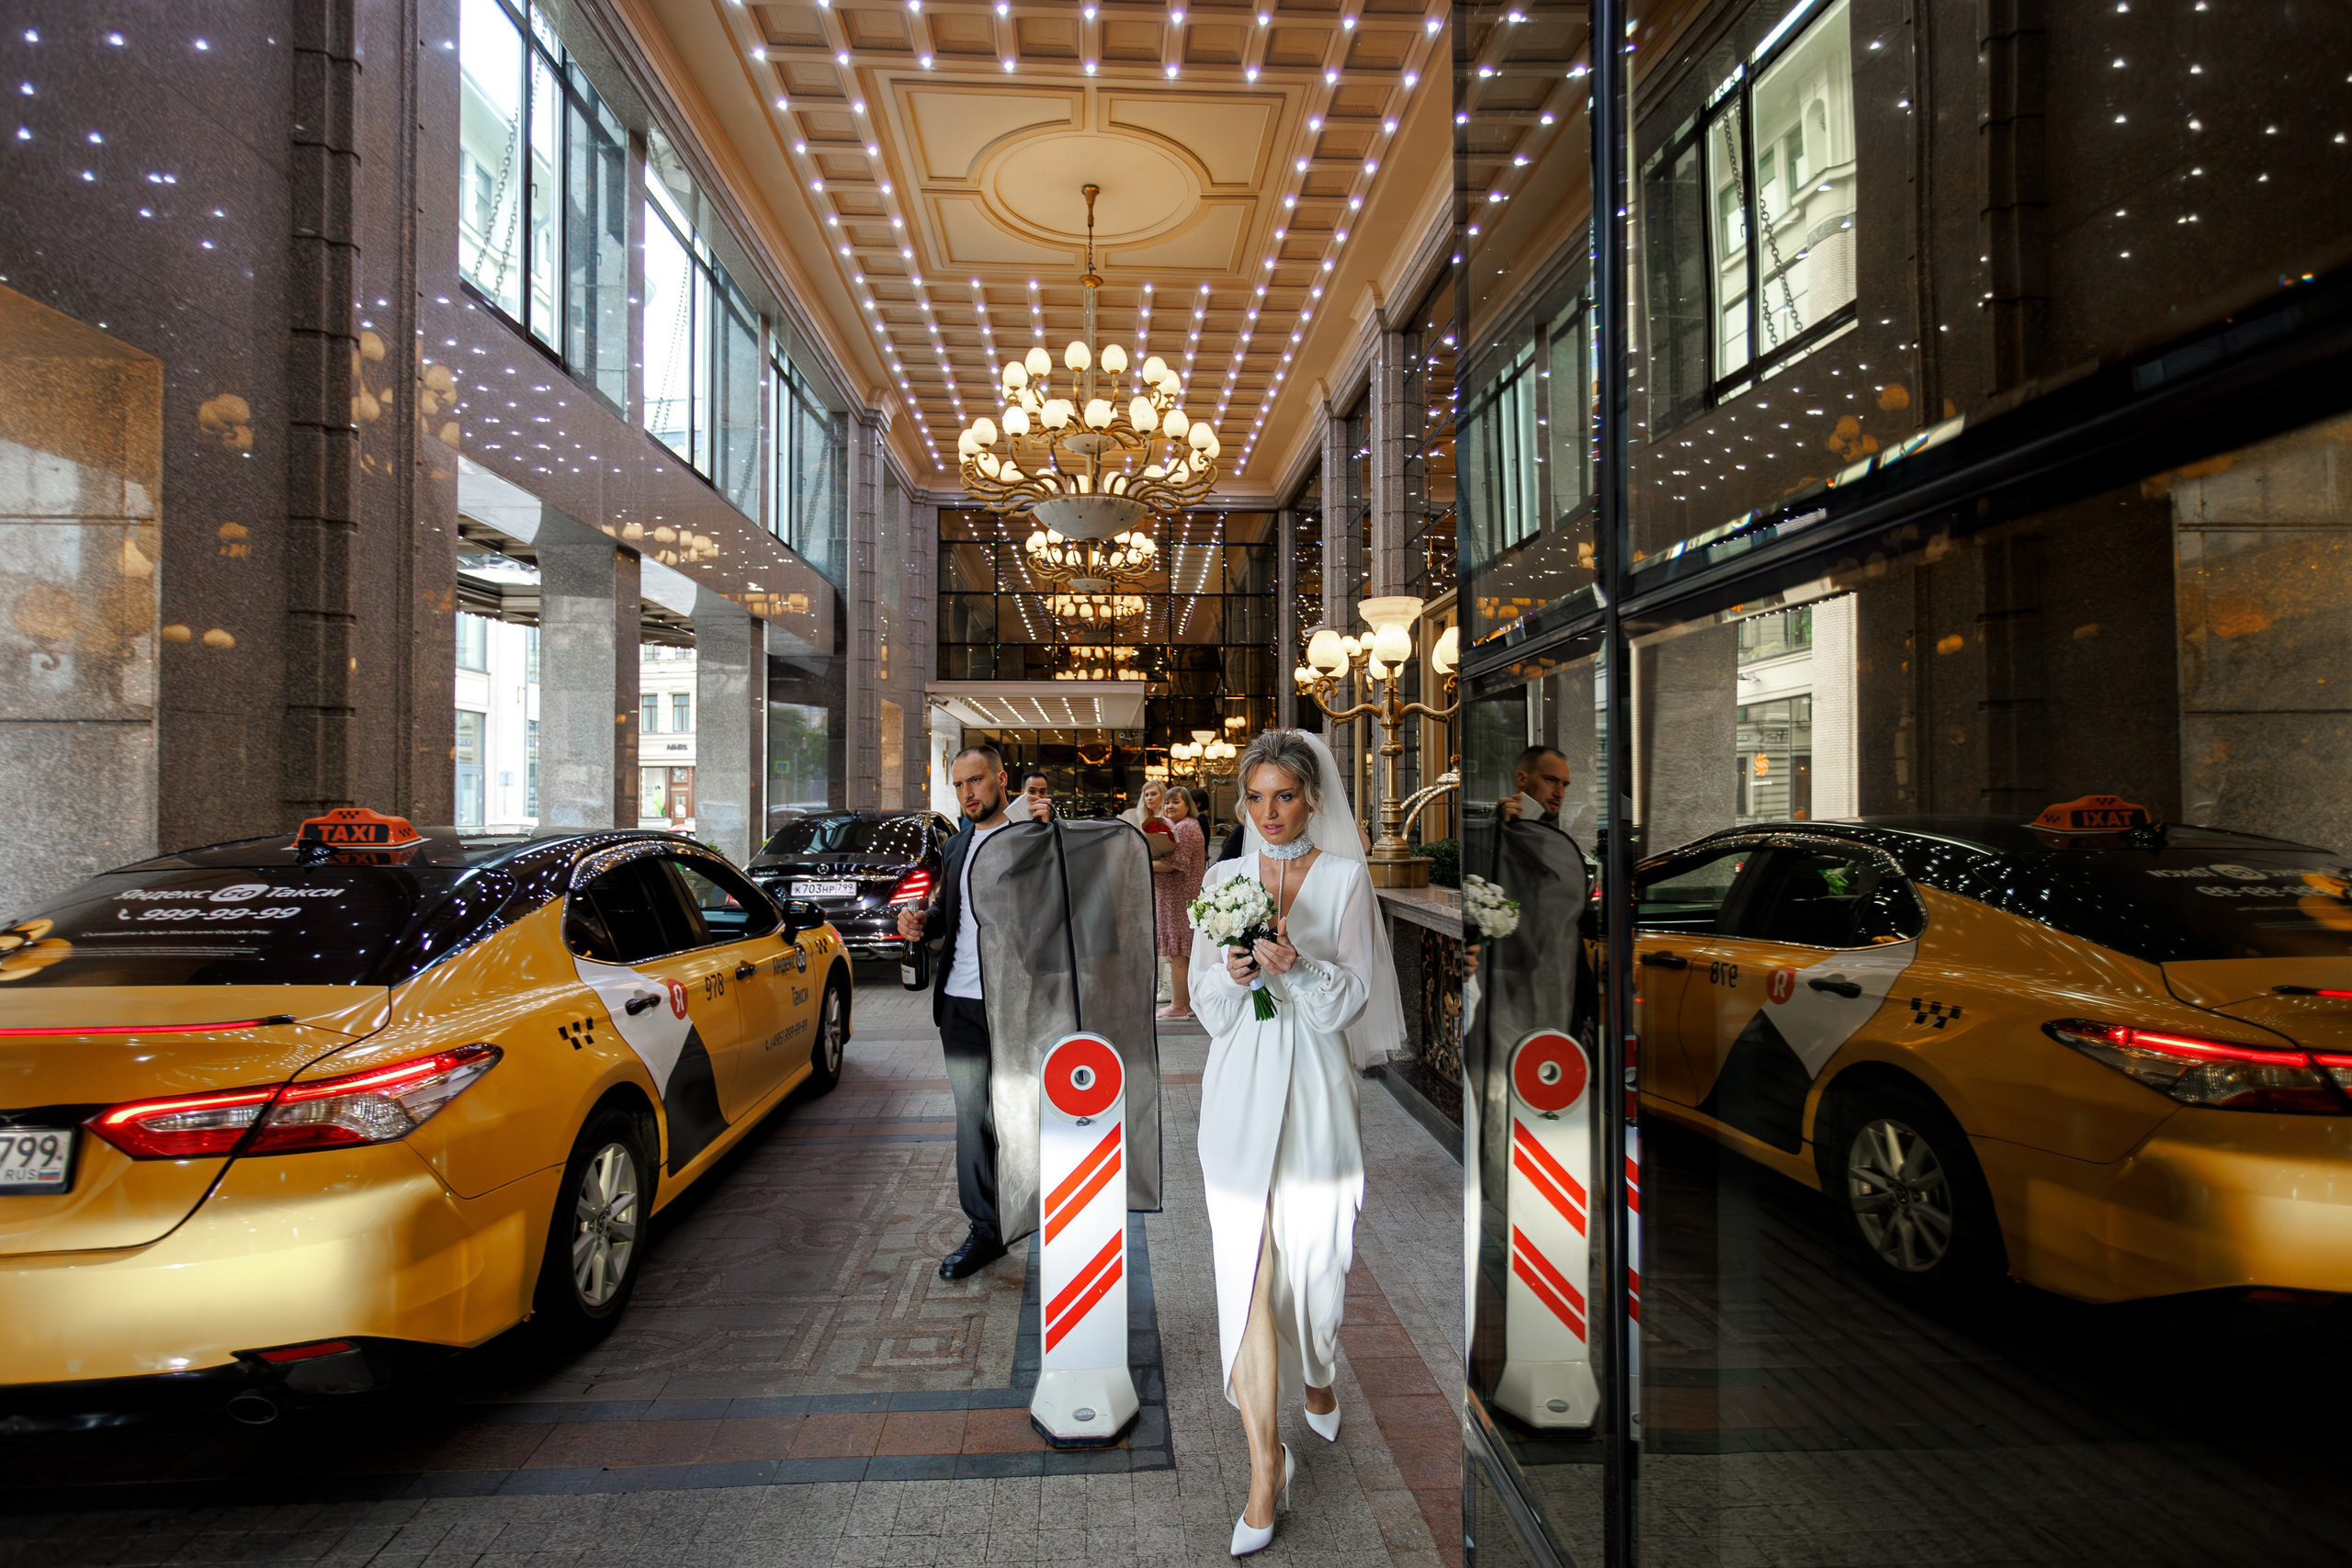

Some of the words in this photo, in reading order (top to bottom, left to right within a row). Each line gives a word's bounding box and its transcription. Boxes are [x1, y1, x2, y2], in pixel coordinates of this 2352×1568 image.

[318, 825, 377, 842] TAXI
[113, 888, 213, 901] Яндекс
[265, 886, 345, 897] Такси
[136, 908, 301, 920] 999-99-99
[705, 972, 724, 1001] 978
[791, 986, 809, 1007] Такси
[0, 1135, 59, 1168] 799
[5, 1168, 38, 1180] RUS
